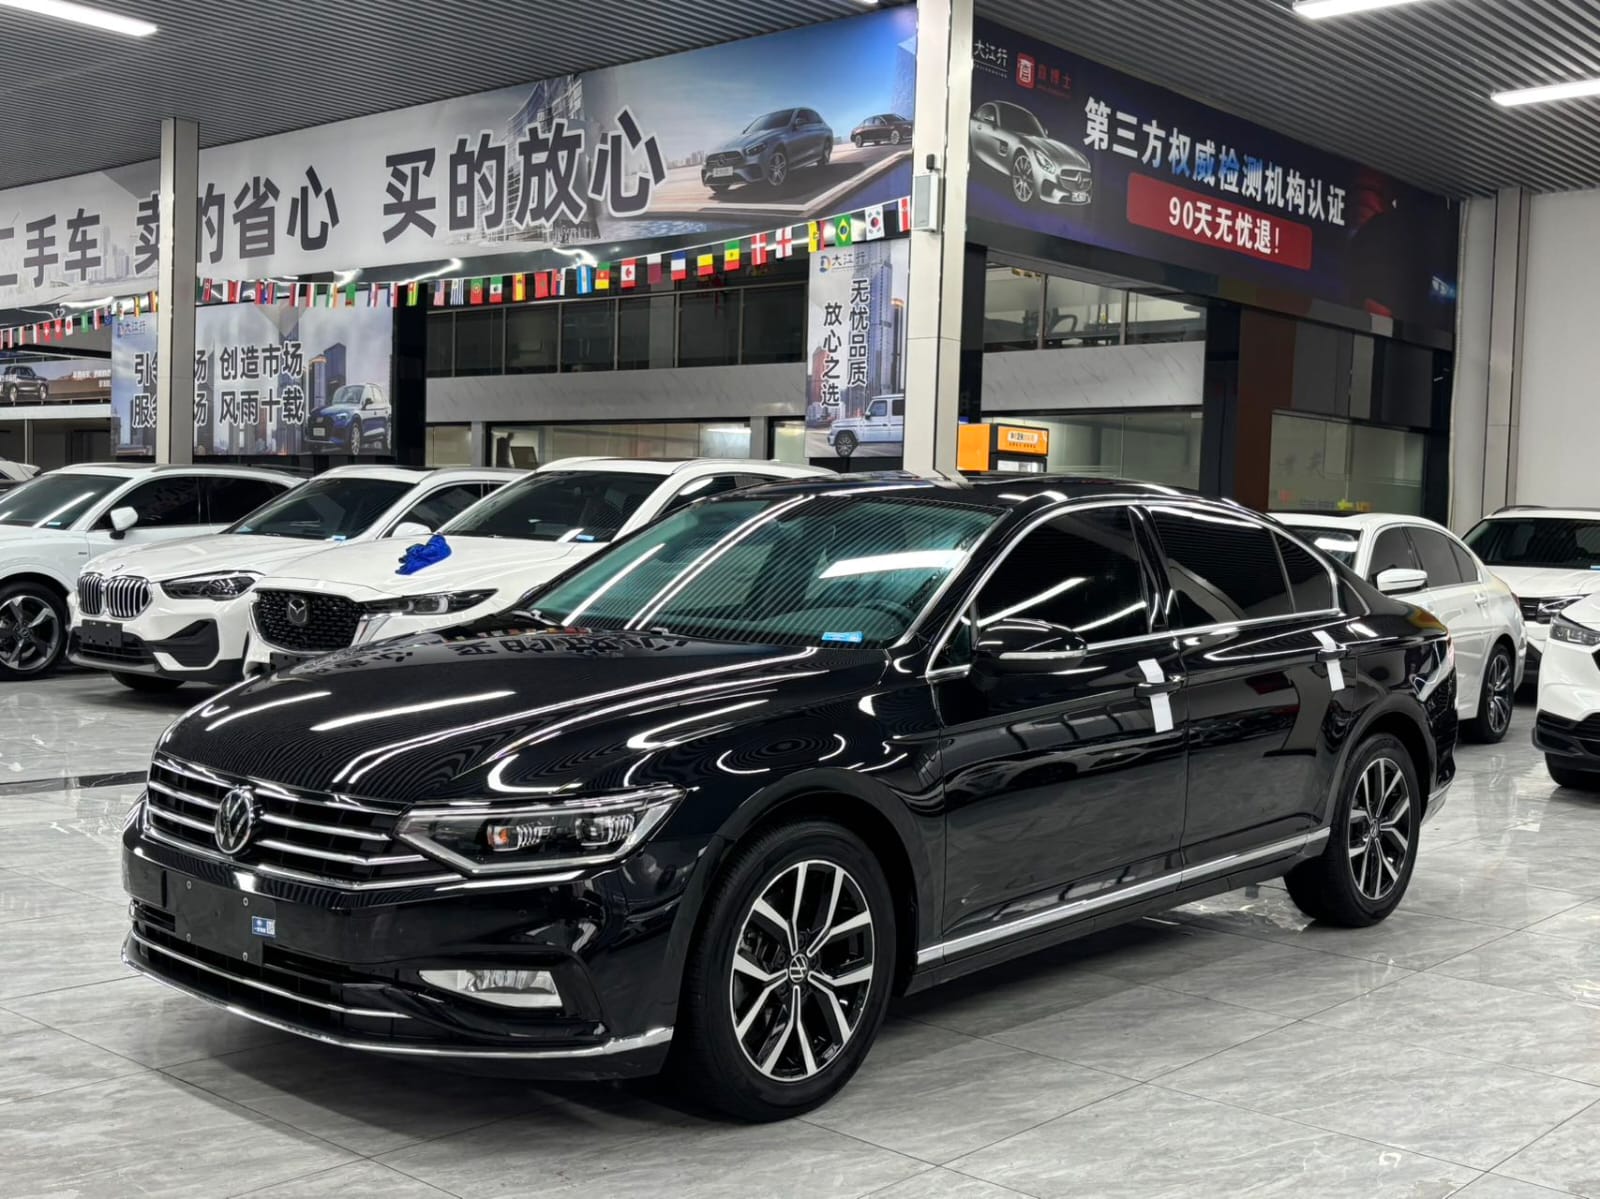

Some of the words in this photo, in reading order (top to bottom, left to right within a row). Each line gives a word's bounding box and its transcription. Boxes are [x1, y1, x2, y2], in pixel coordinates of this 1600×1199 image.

[382, 109, 667, 244] 买的放心
[1083, 97, 1346, 226] 第三方权威检测机构认证
[219, 342, 303, 381] 创造市场
[821, 302, 842, 408] 放心之选
[847, 279, 870, 386] 无忧品质
[219, 387, 304, 425] 风雨十载
